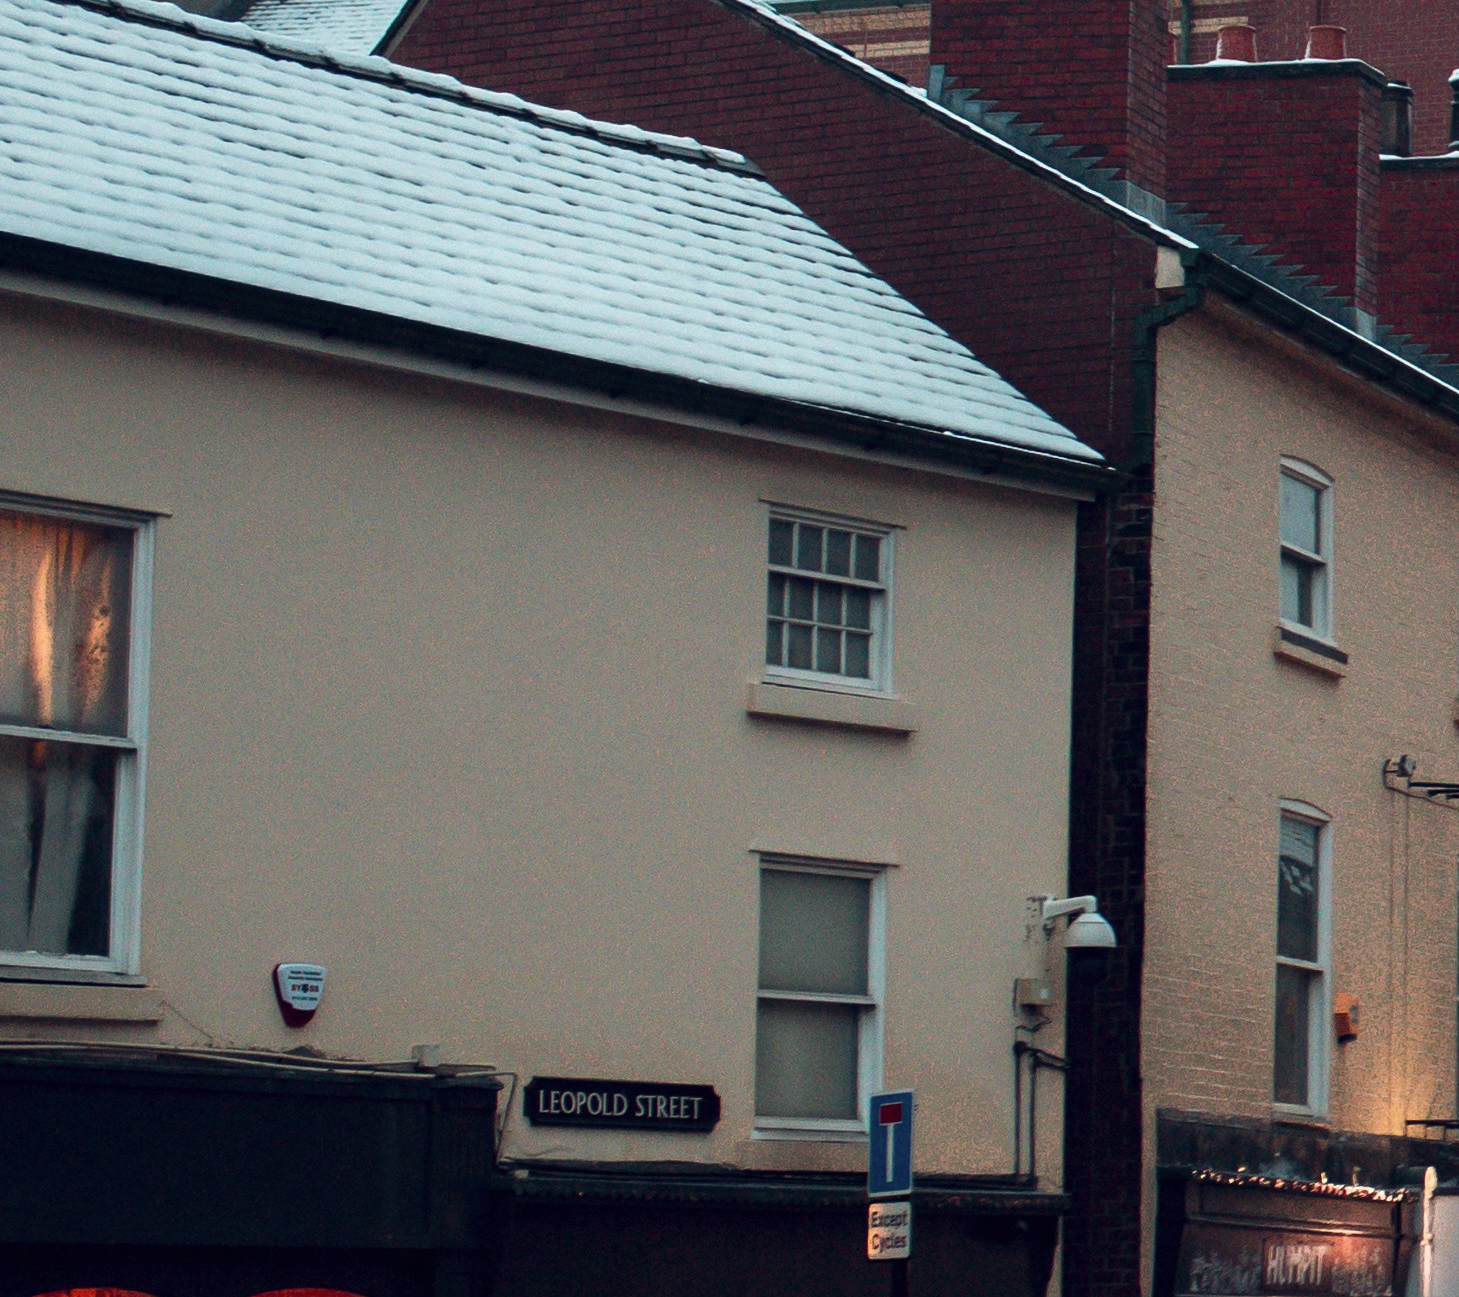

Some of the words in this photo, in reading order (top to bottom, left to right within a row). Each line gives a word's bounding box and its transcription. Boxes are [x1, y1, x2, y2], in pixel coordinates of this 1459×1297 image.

[539, 1089, 628, 1116] LEOPOLD
[635, 1094, 703, 1119] STREET
[871, 1210, 908, 1229] Except
[872, 1233, 907, 1253] Cycles
